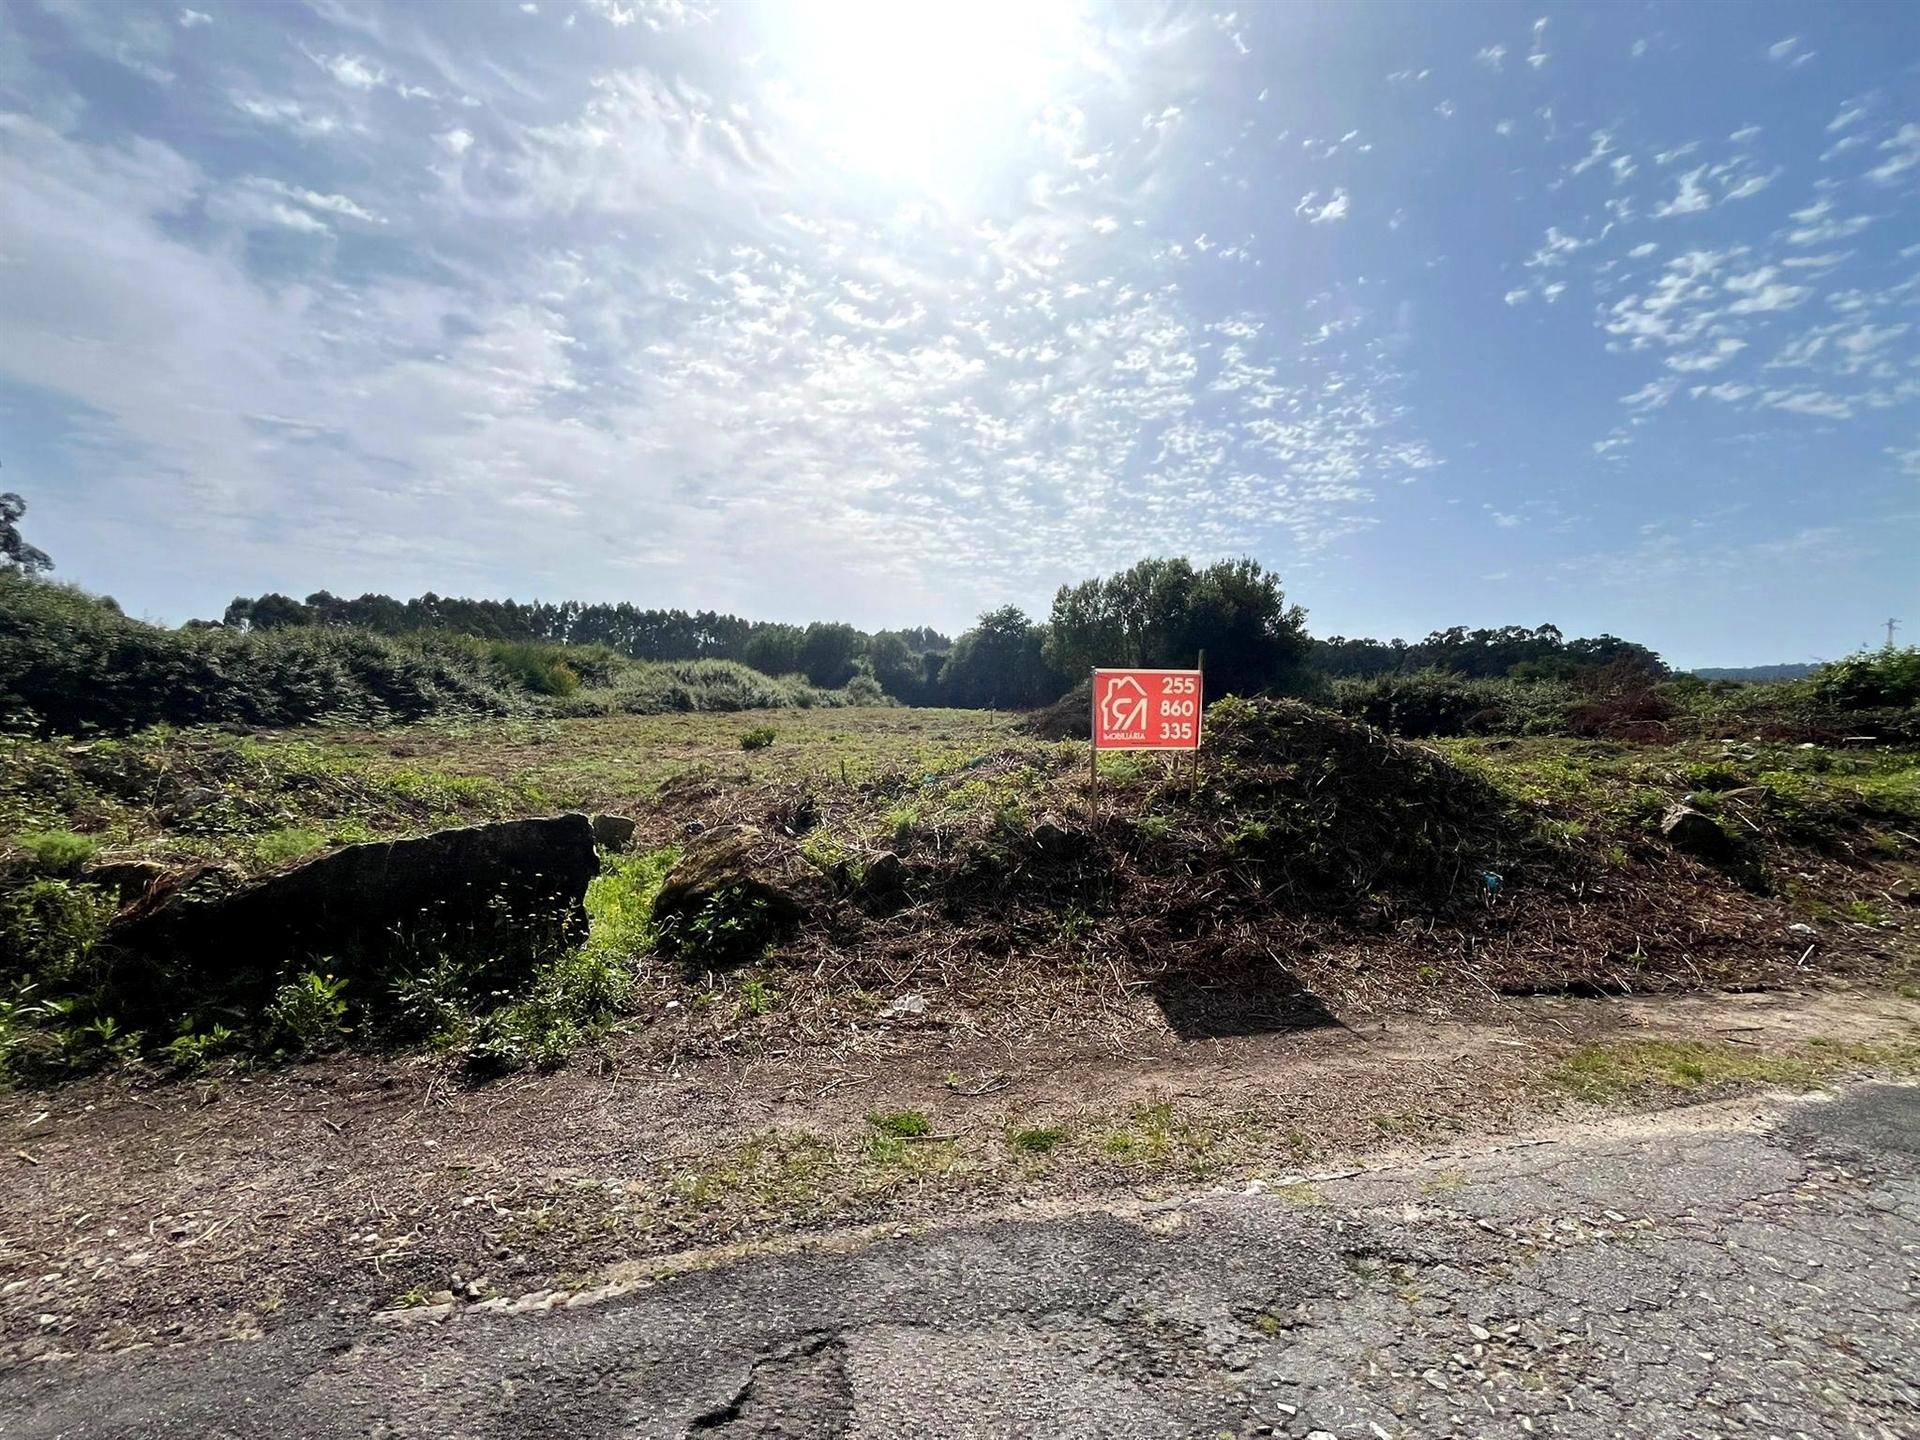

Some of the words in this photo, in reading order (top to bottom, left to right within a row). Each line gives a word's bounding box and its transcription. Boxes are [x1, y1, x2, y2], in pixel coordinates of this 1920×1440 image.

[1161, 677, 1195, 694] 255
[1160, 700, 1194, 717] 860
[1160, 722, 1192, 740] 335
